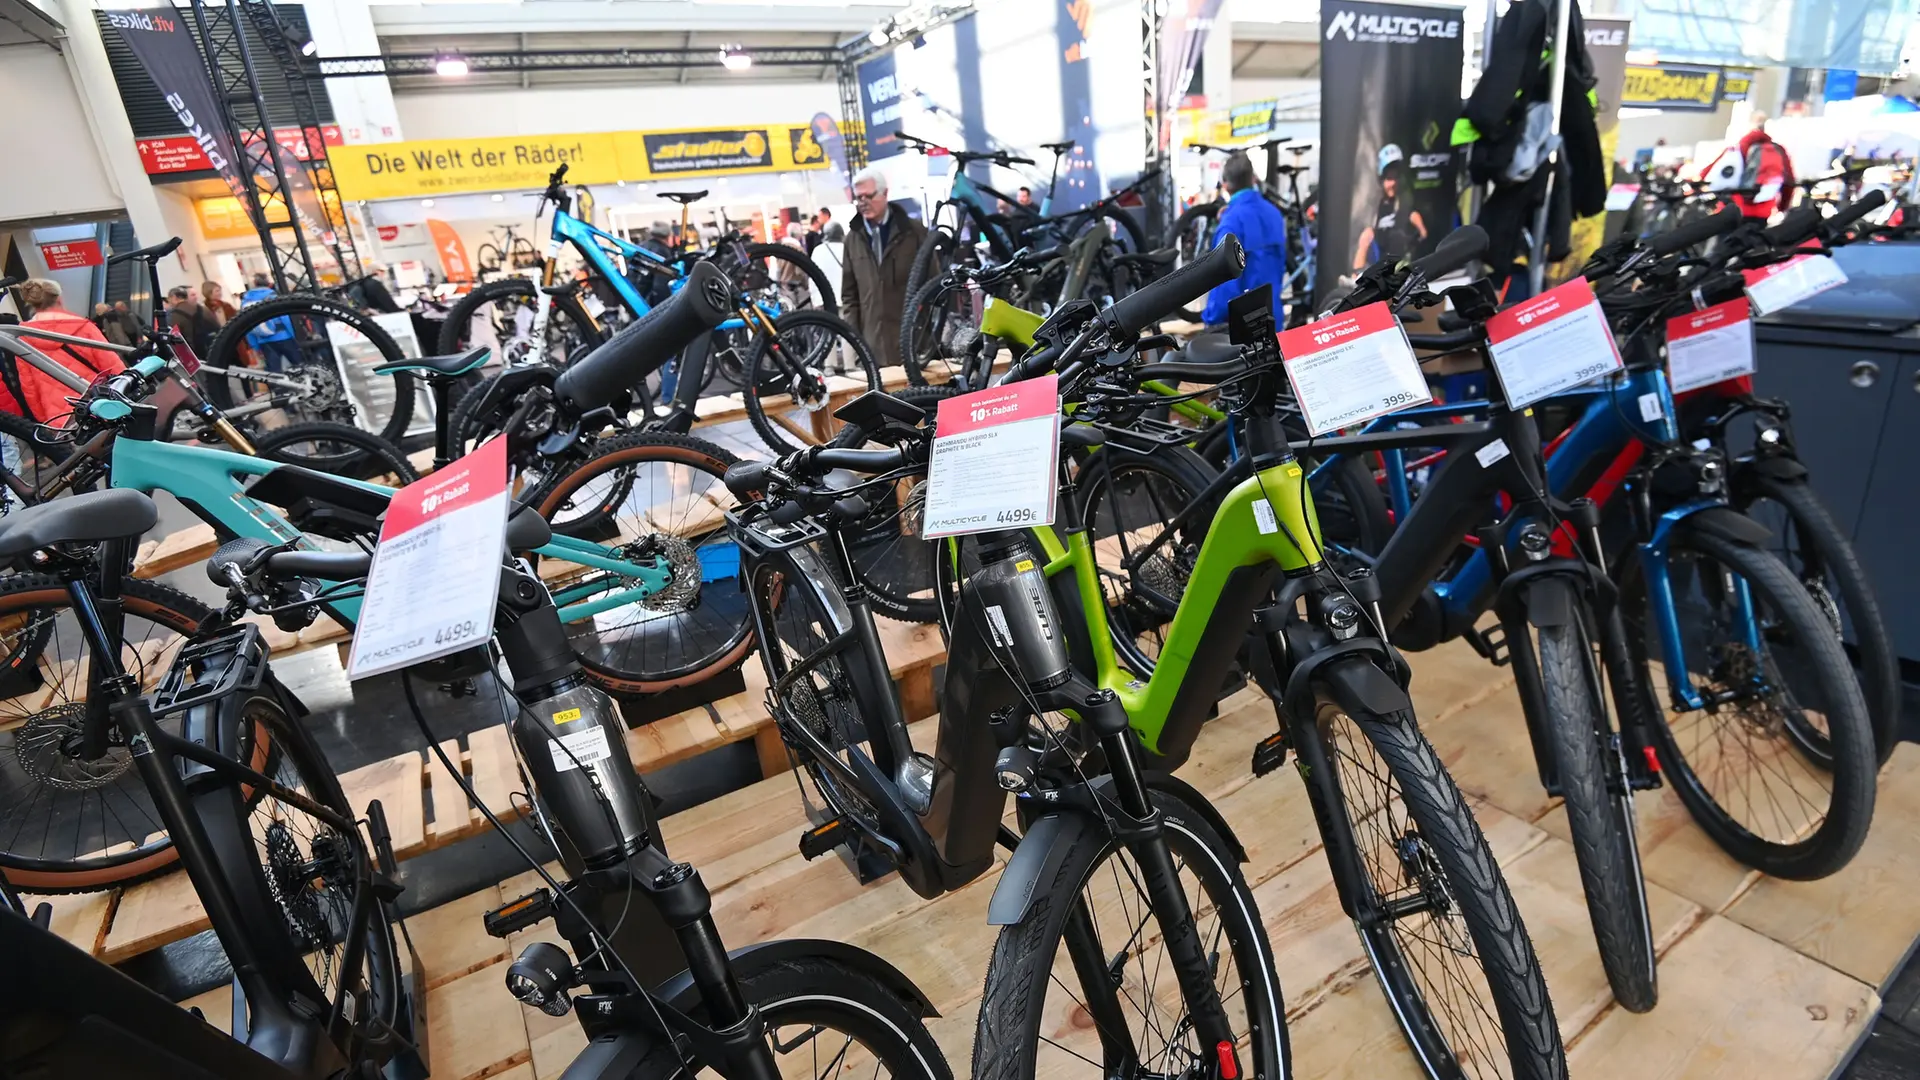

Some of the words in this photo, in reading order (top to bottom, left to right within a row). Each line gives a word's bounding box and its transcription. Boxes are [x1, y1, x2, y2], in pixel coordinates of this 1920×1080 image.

[1358, 14, 1459, 38] MULTICYCLE
[366, 153, 407, 175] Die
[411, 149, 465, 172] Welt
[471, 146, 506, 168] der
[514, 142, 584, 166] Räder!
[311, 304, 362, 325] MAXXIS
[1314, 333, 1336, 345] 10%
[1335, 324, 1360, 337] Rabatt
[1382, 391, 1420, 408] 3999€
[970, 407, 991, 423] 10%
[991, 403, 1019, 416] Rabatt
[1329, 404, 1374, 424] MULTICYCLE
[968, 433, 988, 442] HYBRID
[420, 494, 443, 515] 10%
[442, 481, 470, 503] Rabatt
[940, 514, 987, 526] MULTICYCLE
[996, 508, 1037, 524] 4499€
[1028, 587, 1053, 640] CUBE
[434, 620, 479, 645] 4499€
